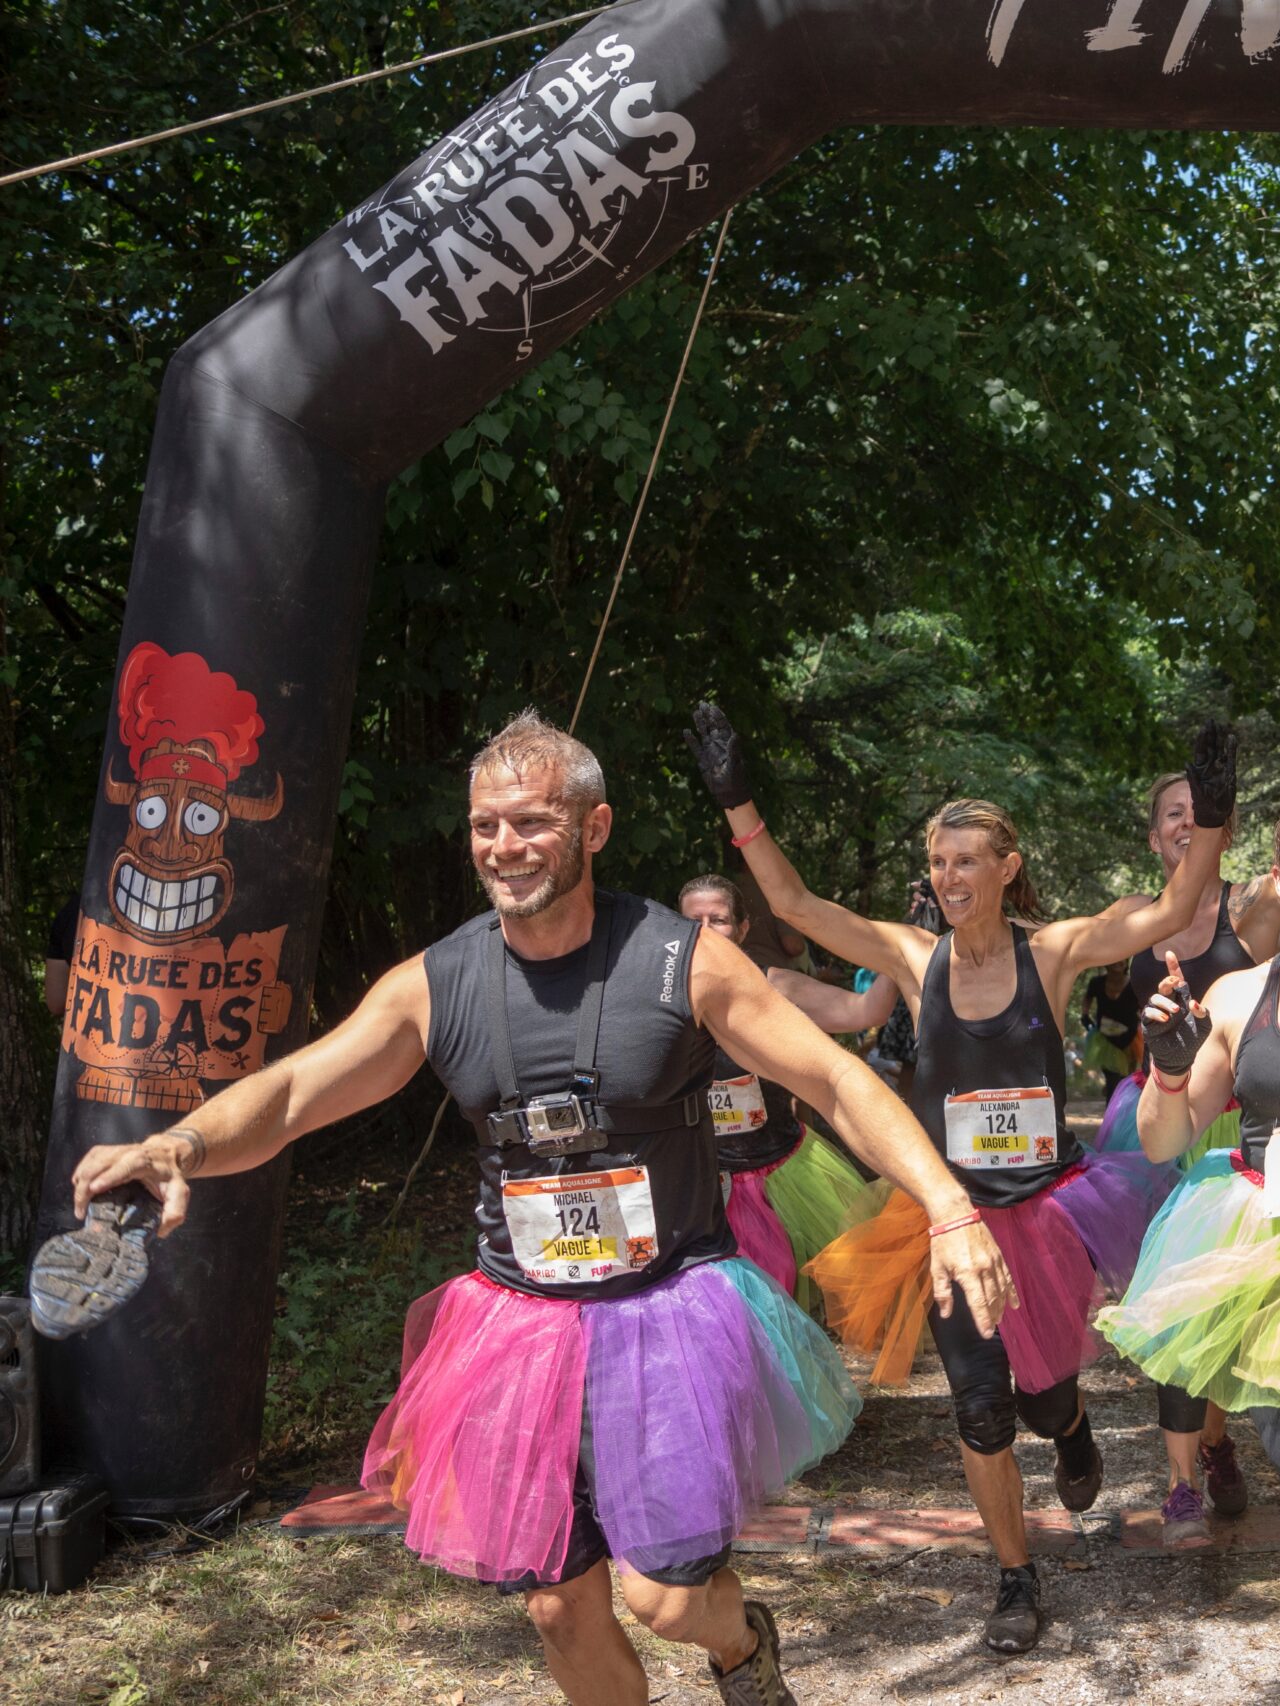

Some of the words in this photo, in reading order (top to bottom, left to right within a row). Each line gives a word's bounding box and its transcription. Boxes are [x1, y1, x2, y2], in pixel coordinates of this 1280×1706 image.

[342, 208, 417, 272] LA
[412, 106, 543, 215] RUEE
[537, 33, 635, 118] DES
[686, 163, 711, 191] E
[372, 80, 696, 355] FADAS
[516, 339, 533, 361] S
[79, 938, 100, 975] LA
[108, 950, 190, 989] RUEE
[199, 958, 262, 990] DES
[660, 955, 677, 1003] Reebok
[70, 974, 256, 1051] FADAS
[708, 1094, 733, 1110] 124
[980, 1102, 1020, 1111] ALEXANDRA
[985, 1113, 1018, 1134] 124
[981, 1137, 1009, 1149] VAGUE
[1015, 1136, 1019, 1147] 1
[541, 1181, 561, 1190] TEAM
[562, 1178, 602, 1189] AQUALIGNE
[553, 1191, 595, 1206] MICHAEL
[556, 1206, 601, 1236] 124
[553, 1240, 592, 1256] VAGUE
[596, 1240, 604, 1254] 1
